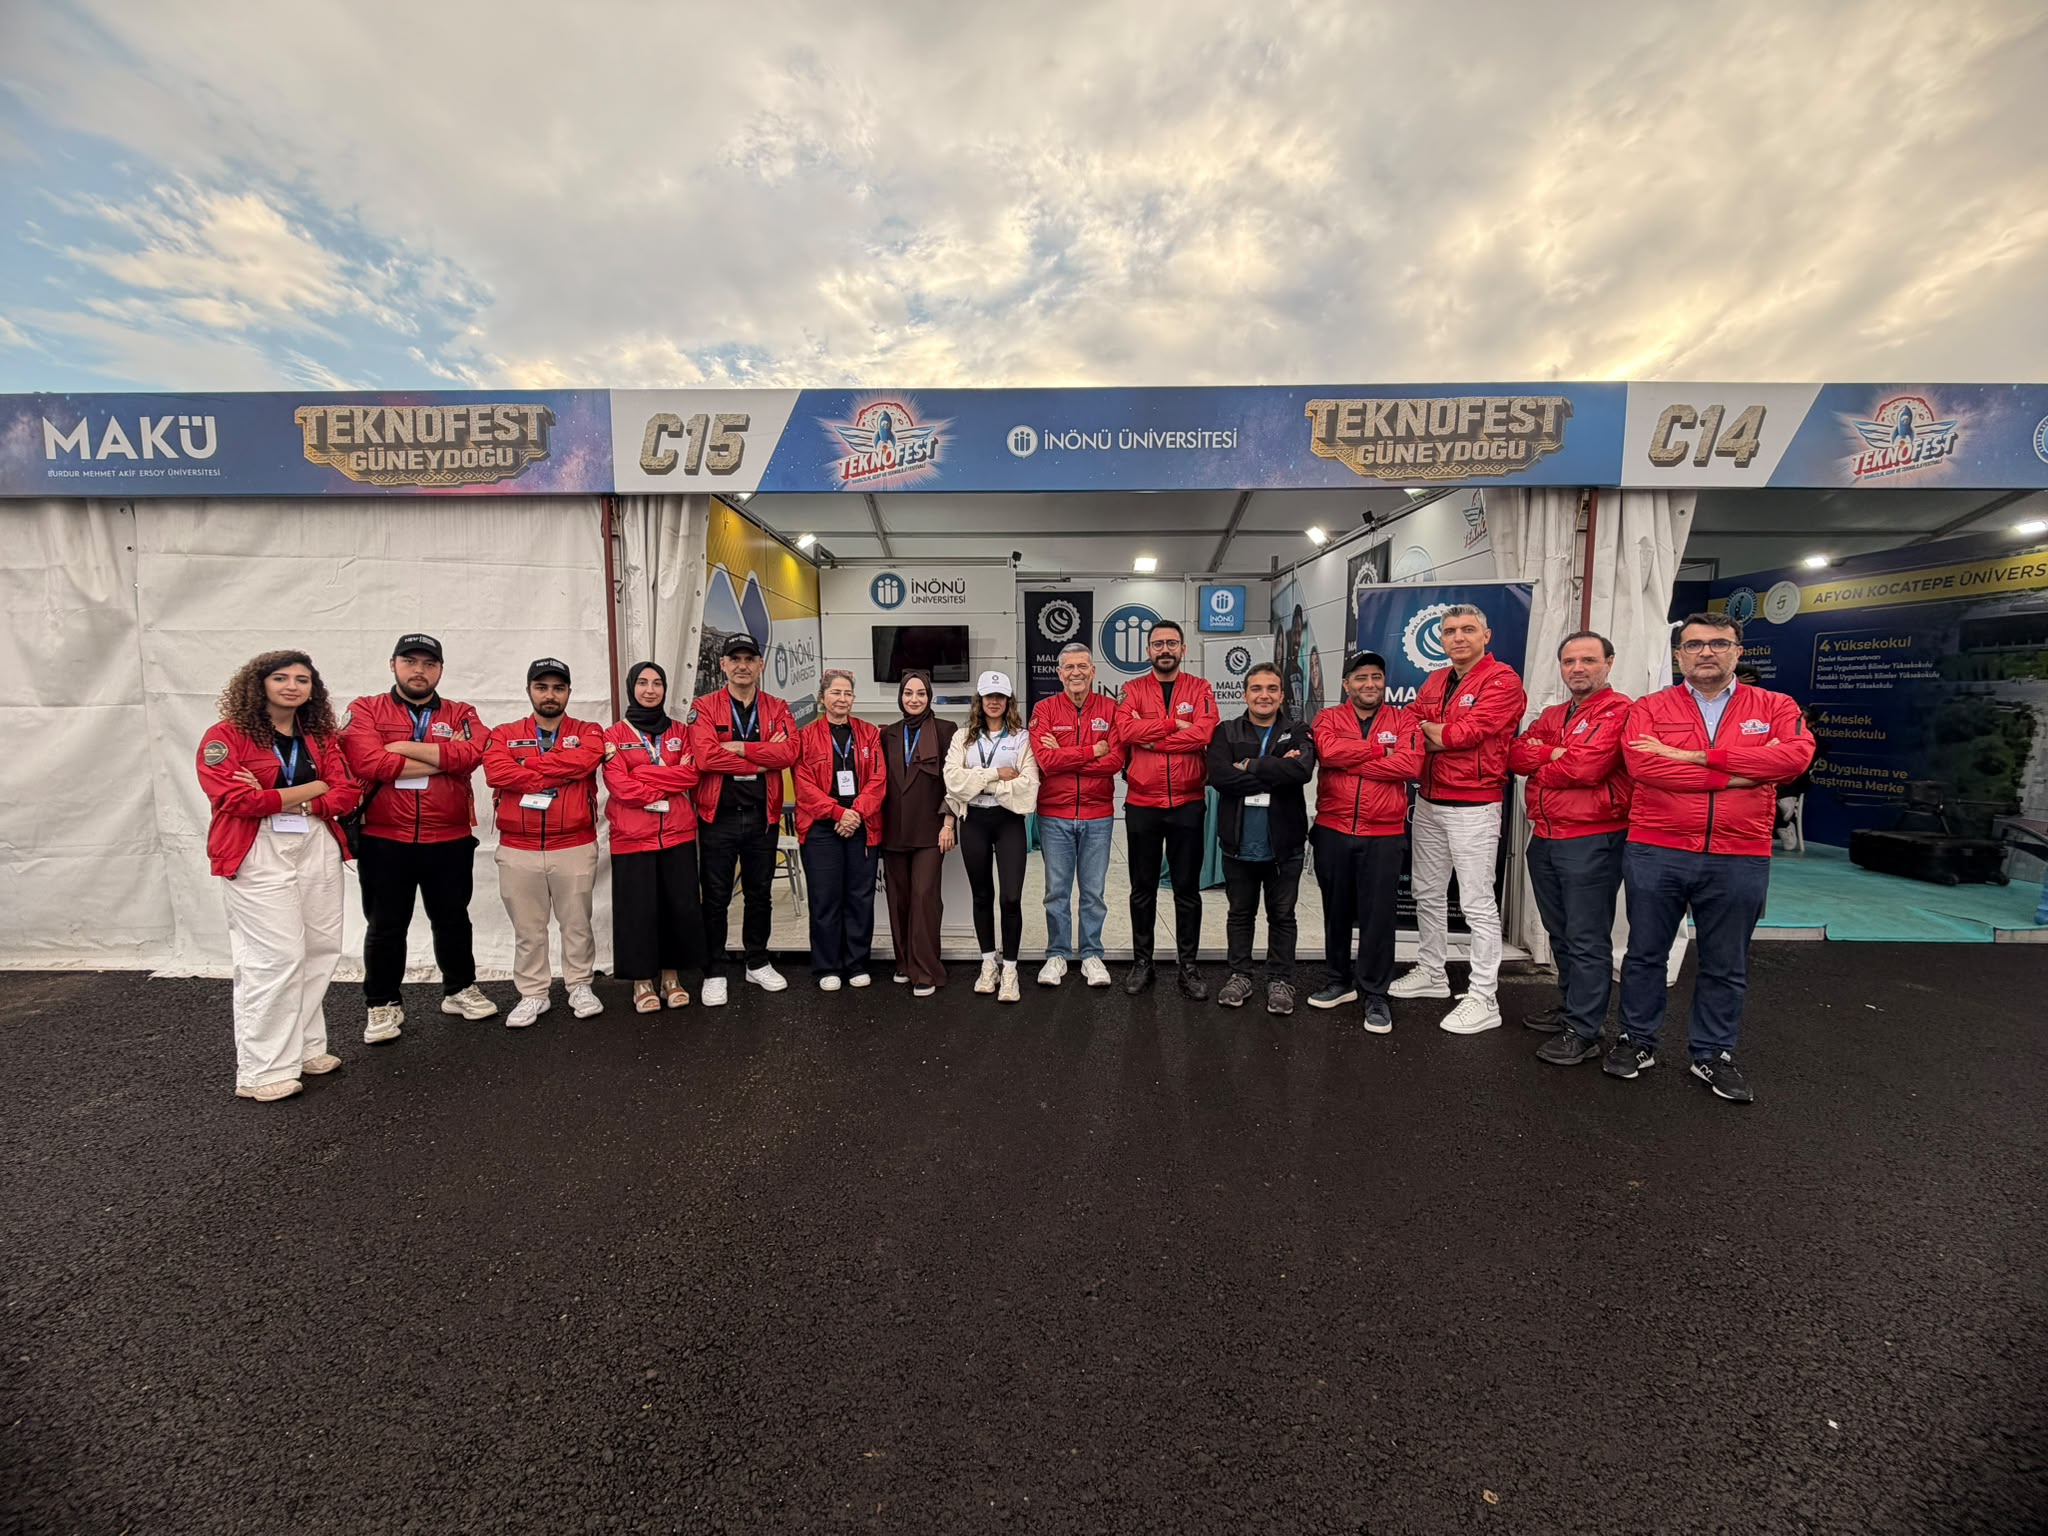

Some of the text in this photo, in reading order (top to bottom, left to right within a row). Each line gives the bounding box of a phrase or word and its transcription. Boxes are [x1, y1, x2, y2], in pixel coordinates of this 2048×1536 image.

[297, 405, 547, 446] TEKNOFEST
[1307, 398, 1565, 439] TEKNOFEST
[42, 415, 217, 460] MAKÜ
[639, 412, 750, 476] C15
[1044, 428, 1238, 450] İNÖNÜ ÜNİVERSİTESİ
[1648, 404, 1767, 469] C14
[351, 445, 514, 472] GÜNEYDOĞU
[839, 436, 939, 480] TEKNOFEST
[1357, 437, 1526, 465] GÜNEYDOĞU
[1852, 432, 1958, 476] TEKNOFEST
[47, 467, 221, 478] BURDUR MEHMET AKİF ERSOY ÜNİVERSİTESİ
[911, 578, 965, 594] İNÖNÜ
[911, 594, 966, 604] ÜNİVERSİTESİ
[1814, 588, 1863, 604] AFYON
[1867, 576, 1955, 598] KOCATEPE
[1210, 614, 1234, 622] İNÖNÜ
[1819, 635, 1912, 652] 4 Yüksekokul
[1032, 665, 1057, 674] TEKN
[1831, 715, 1873, 725] Meslek
[1829, 763, 1889, 777] Uygulama
[1892, 770, 1909, 779] ve
